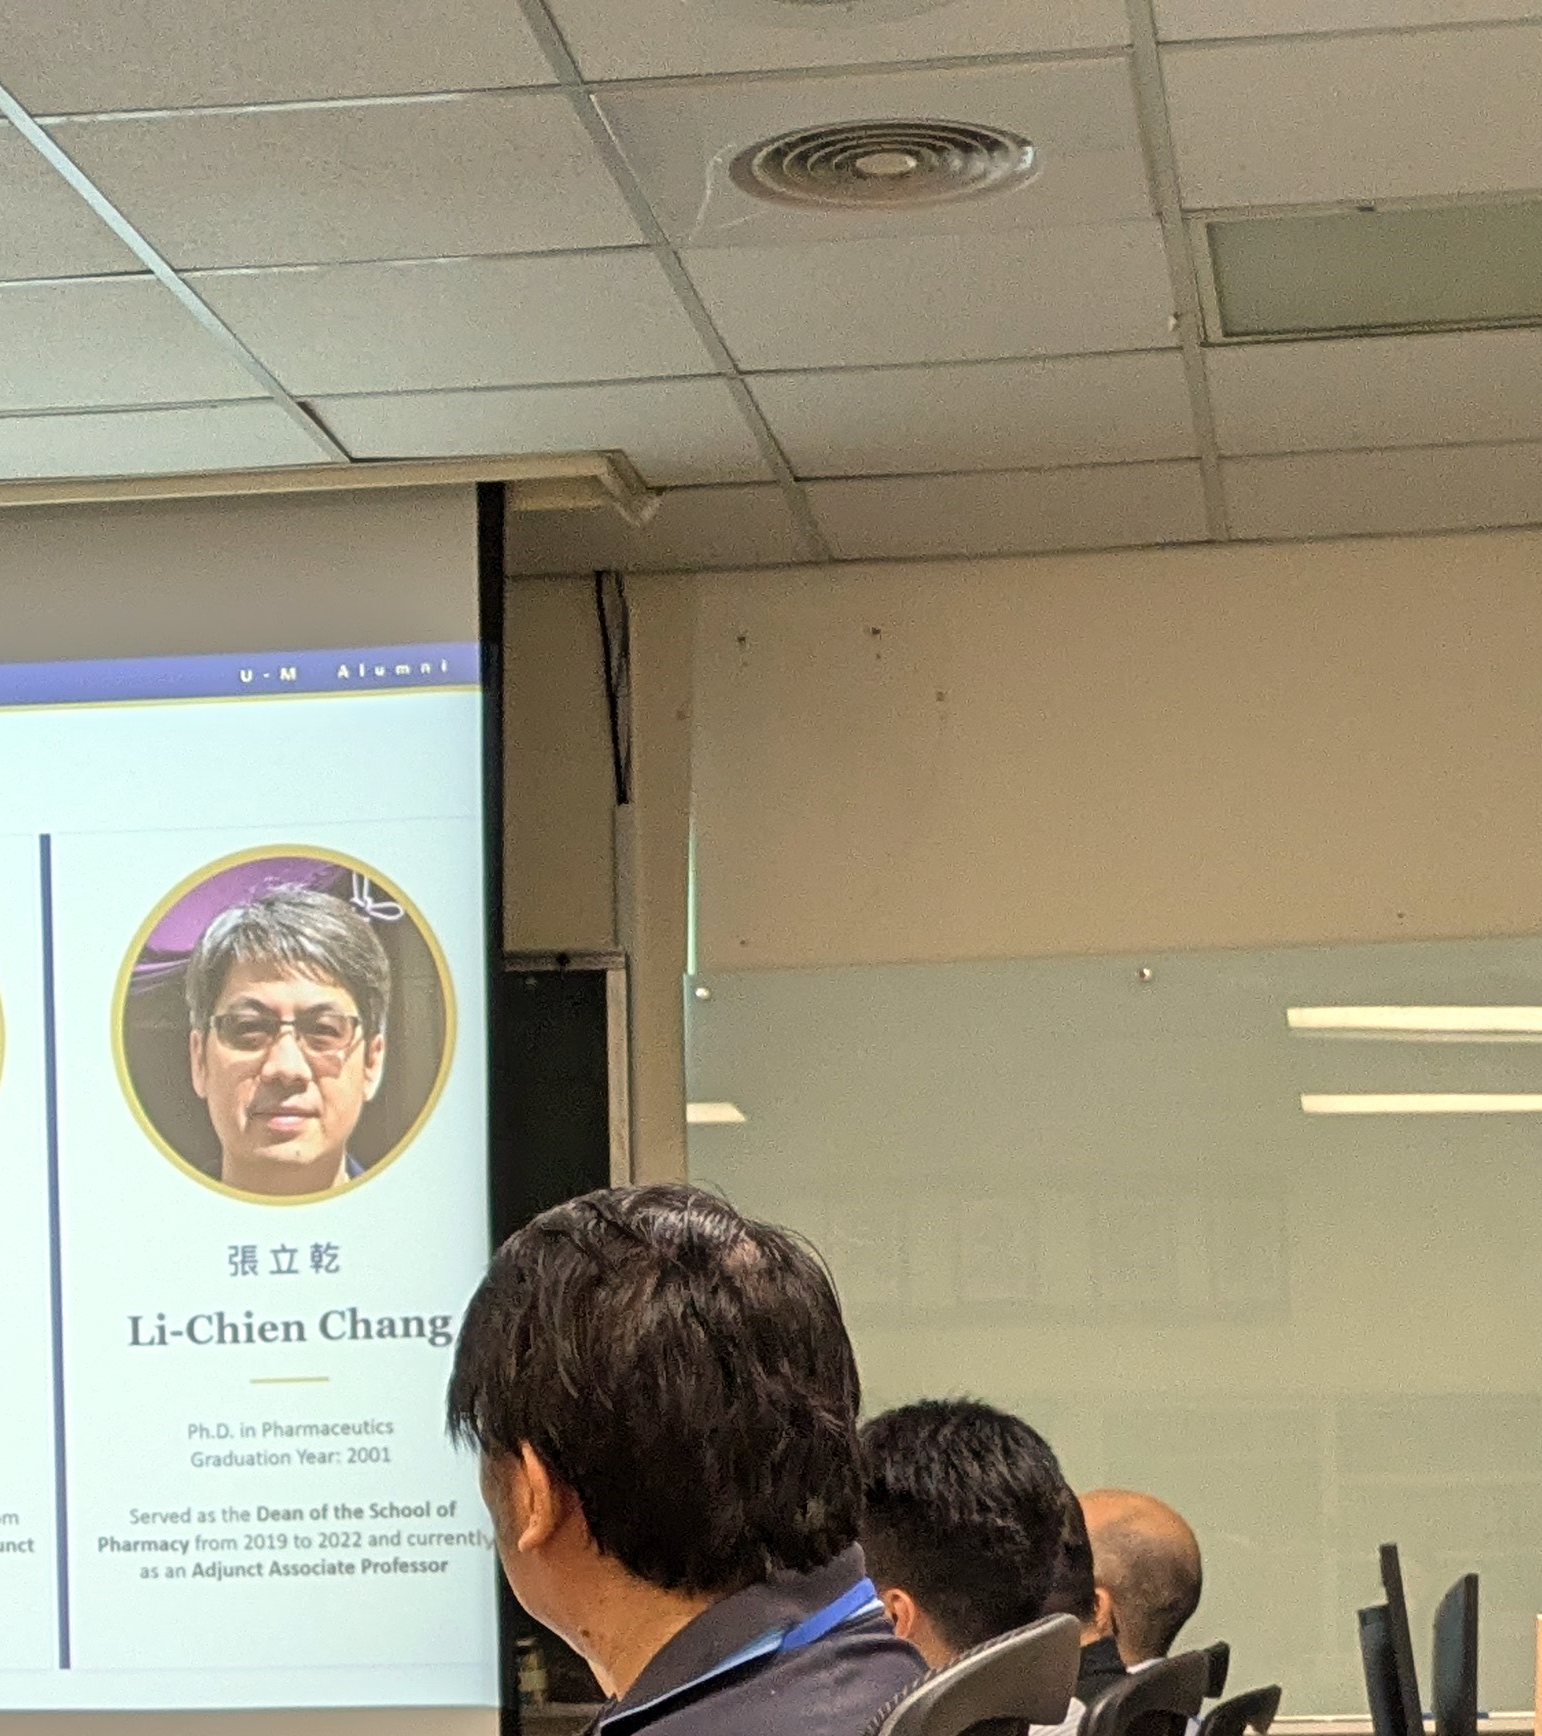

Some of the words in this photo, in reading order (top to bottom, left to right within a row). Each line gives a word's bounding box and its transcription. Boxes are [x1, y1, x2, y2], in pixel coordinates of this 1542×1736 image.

[337, 659, 449, 679] Alumni
[228, 1241, 341, 1277] 張立乾
[128, 1310, 307, 1346] Li-Chien
[318, 1306, 453, 1348] Chang
[187, 1422, 234, 1440] Ph.D.
[239, 1422, 257, 1438] in
[261, 1418, 395, 1438] Pharmaceutics
[190, 1450, 292, 1468] Graduation
[296, 1448, 341, 1465] Year:
[347, 1446, 392, 1465] 2001
[129, 1507, 192, 1525] Served
[197, 1510, 216, 1524] as
[221, 1506, 251, 1523] the
[256, 1505, 304, 1522] Dean
[309, 1503, 329, 1521] of
[333, 1503, 365, 1520] the
[368, 1500, 431, 1520] School
[435, 1499, 458, 1519] of
[97, 1535, 190, 1556] Pharmacy
[194, 1534, 238, 1551] from
[244, 1533, 288, 1551] 2019
[293, 1534, 313, 1549] to
[318, 1531, 362, 1549] 2022
[368, 1529, 402, 1548] and
[406, 1529, 493, 1551] currently
[140, 1566, 159, 1579] as
[165, 1566, 186, 1579] an
[191, 1561, 264, 1582] Adjunct
[268, 1558, 356, 1577] Associate
[360, 1556, 449, 1575] Professor
